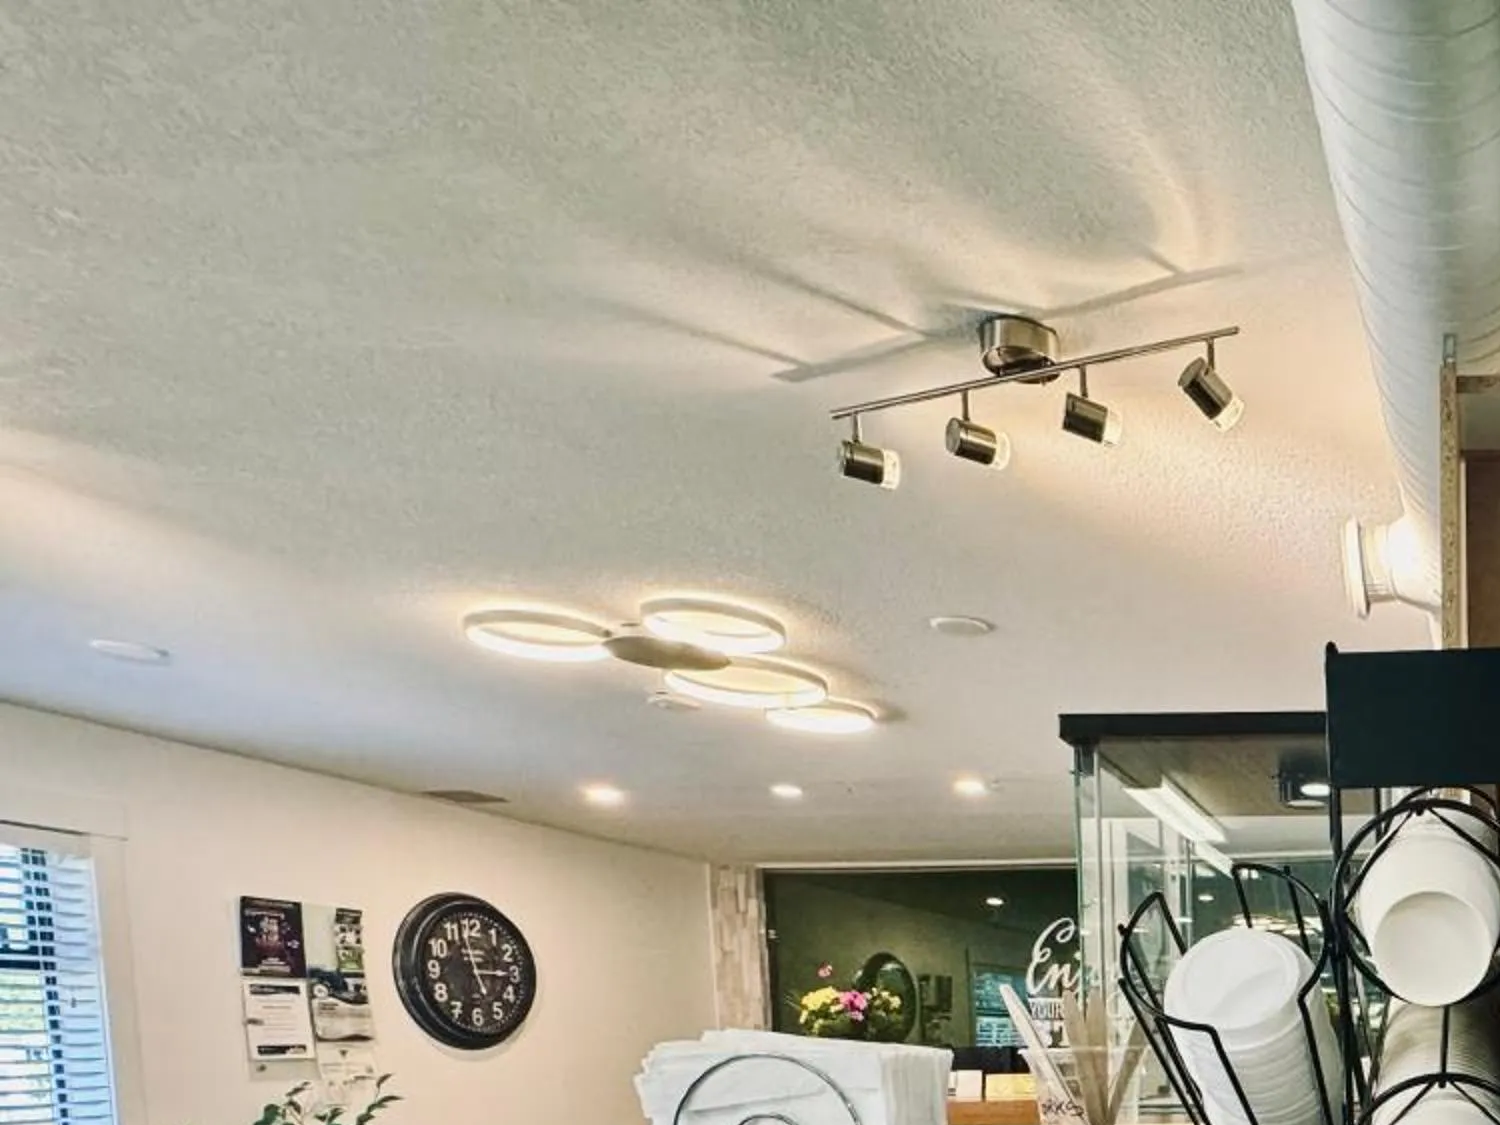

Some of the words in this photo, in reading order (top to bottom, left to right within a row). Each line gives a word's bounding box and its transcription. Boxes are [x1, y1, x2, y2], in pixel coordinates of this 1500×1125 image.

[443, 922, 459, 940] 11
[461, 919, 480, 938] 12
[488, 928, 497, 946] 1
[428, 939, 448, 958] 10
[501, 944, 513, 962] 2
[427, 960, 440, 979] 9
[509, 965, 520, 983] 3
[434, 983, 448, 1003] 8
[503, 985, 515, 1003] 4
[472, 1008, 484, 1026] 6
[492, 1002, 503, 1020] 5
